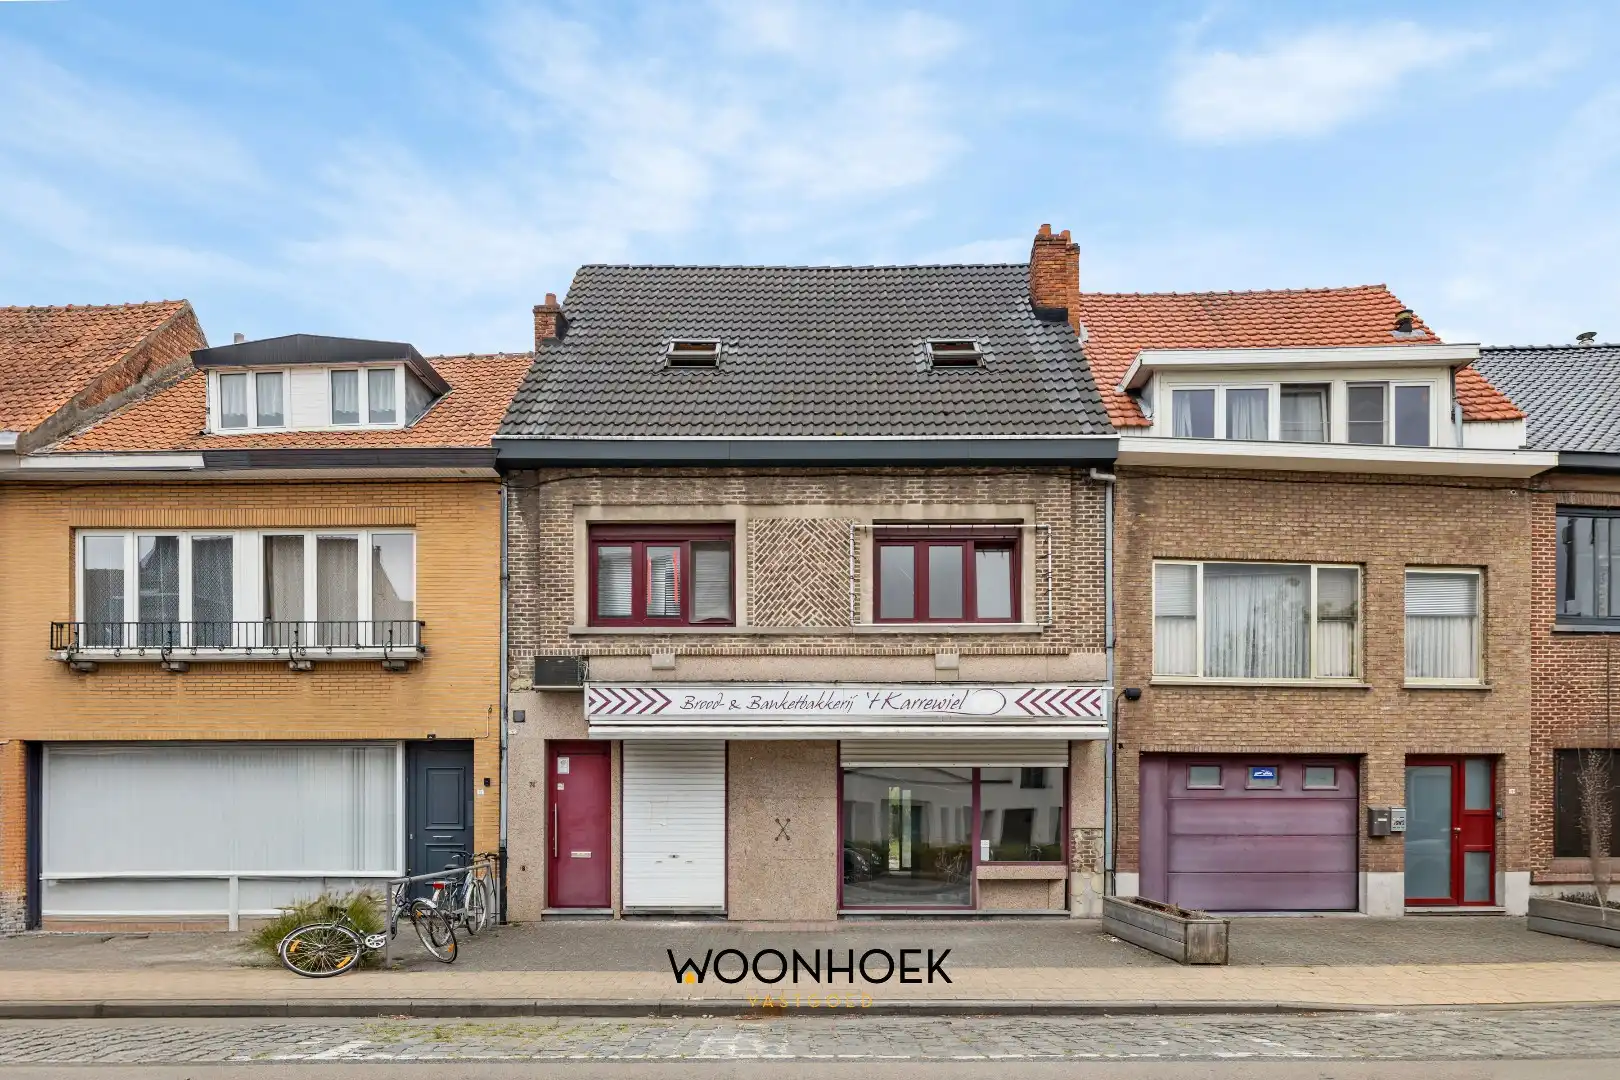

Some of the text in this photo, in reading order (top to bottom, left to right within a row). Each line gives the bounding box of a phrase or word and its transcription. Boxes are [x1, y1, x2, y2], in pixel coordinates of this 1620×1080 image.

[728, 699, 742, 711] &
[746, 690, 859, 714] Banketbakkerij
[880, 689, 970, 711] Karrewiel
